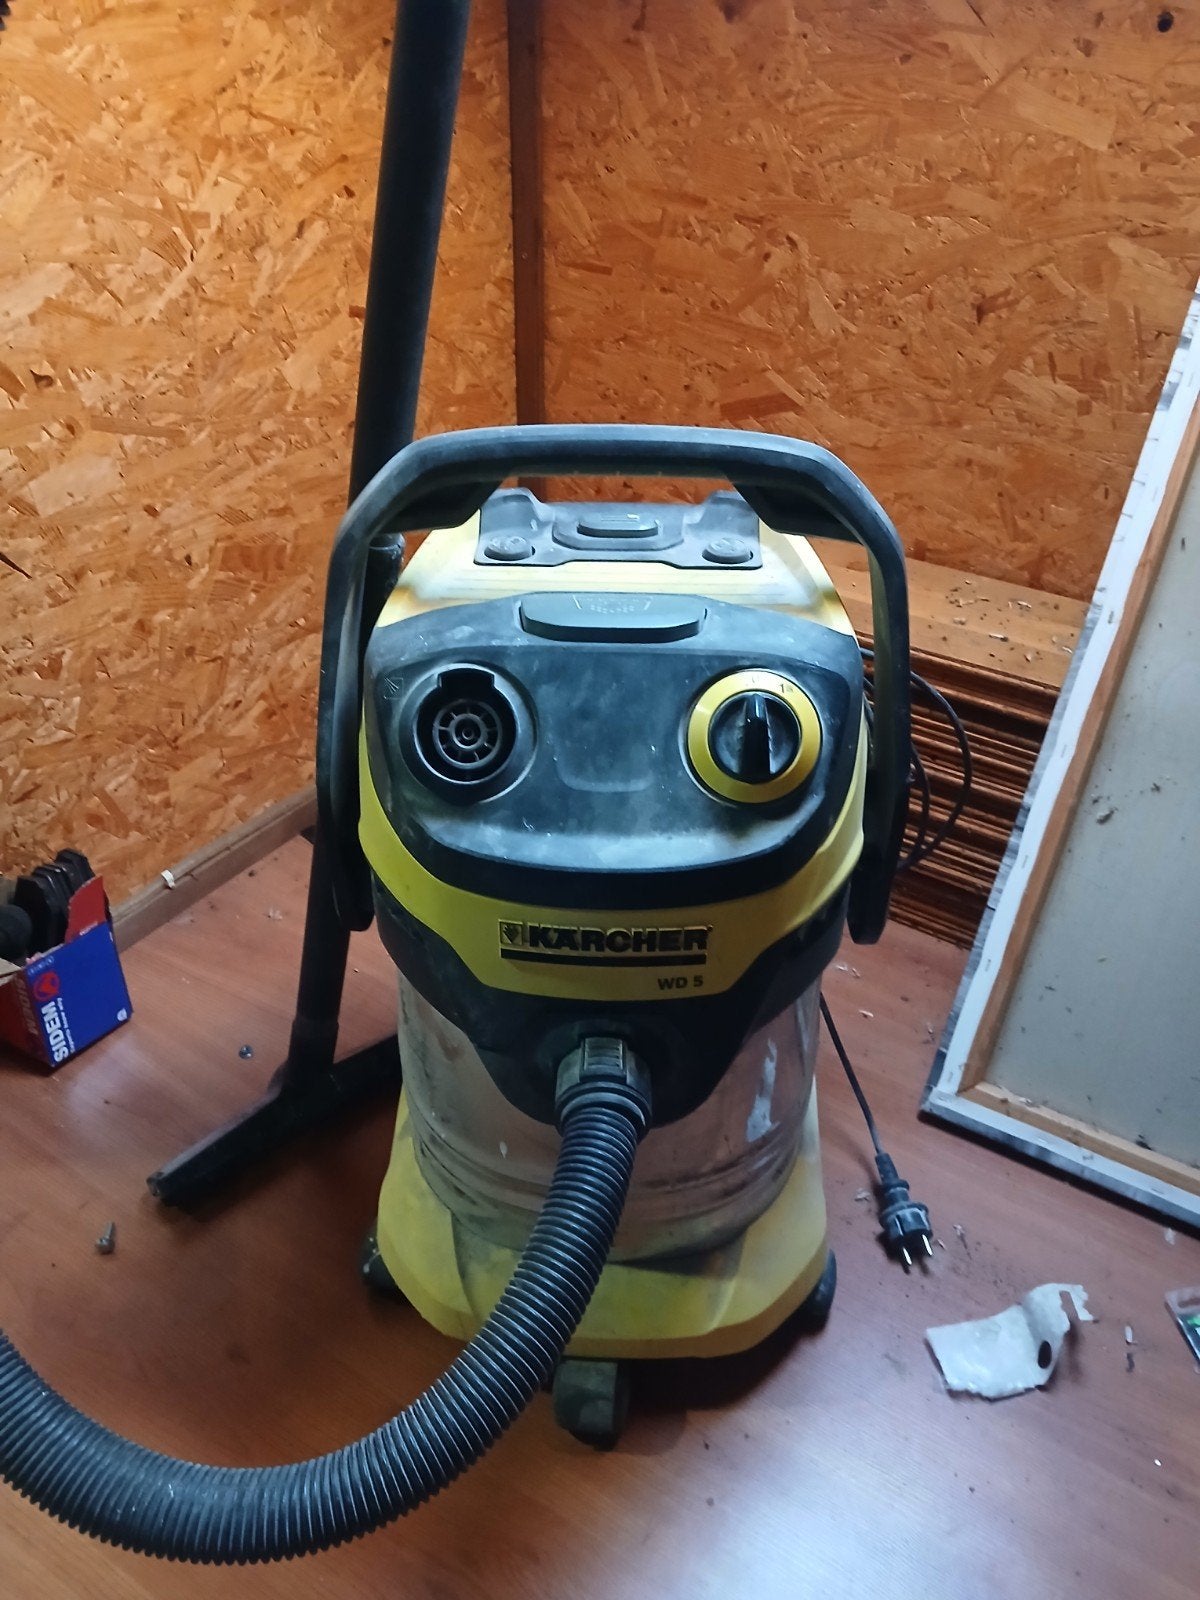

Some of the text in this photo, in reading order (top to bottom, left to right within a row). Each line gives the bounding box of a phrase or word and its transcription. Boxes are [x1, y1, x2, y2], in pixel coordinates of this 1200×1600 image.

[657, 975, 704, 990] WD 5
[41, 1001, 69, 1062] SIDEM
